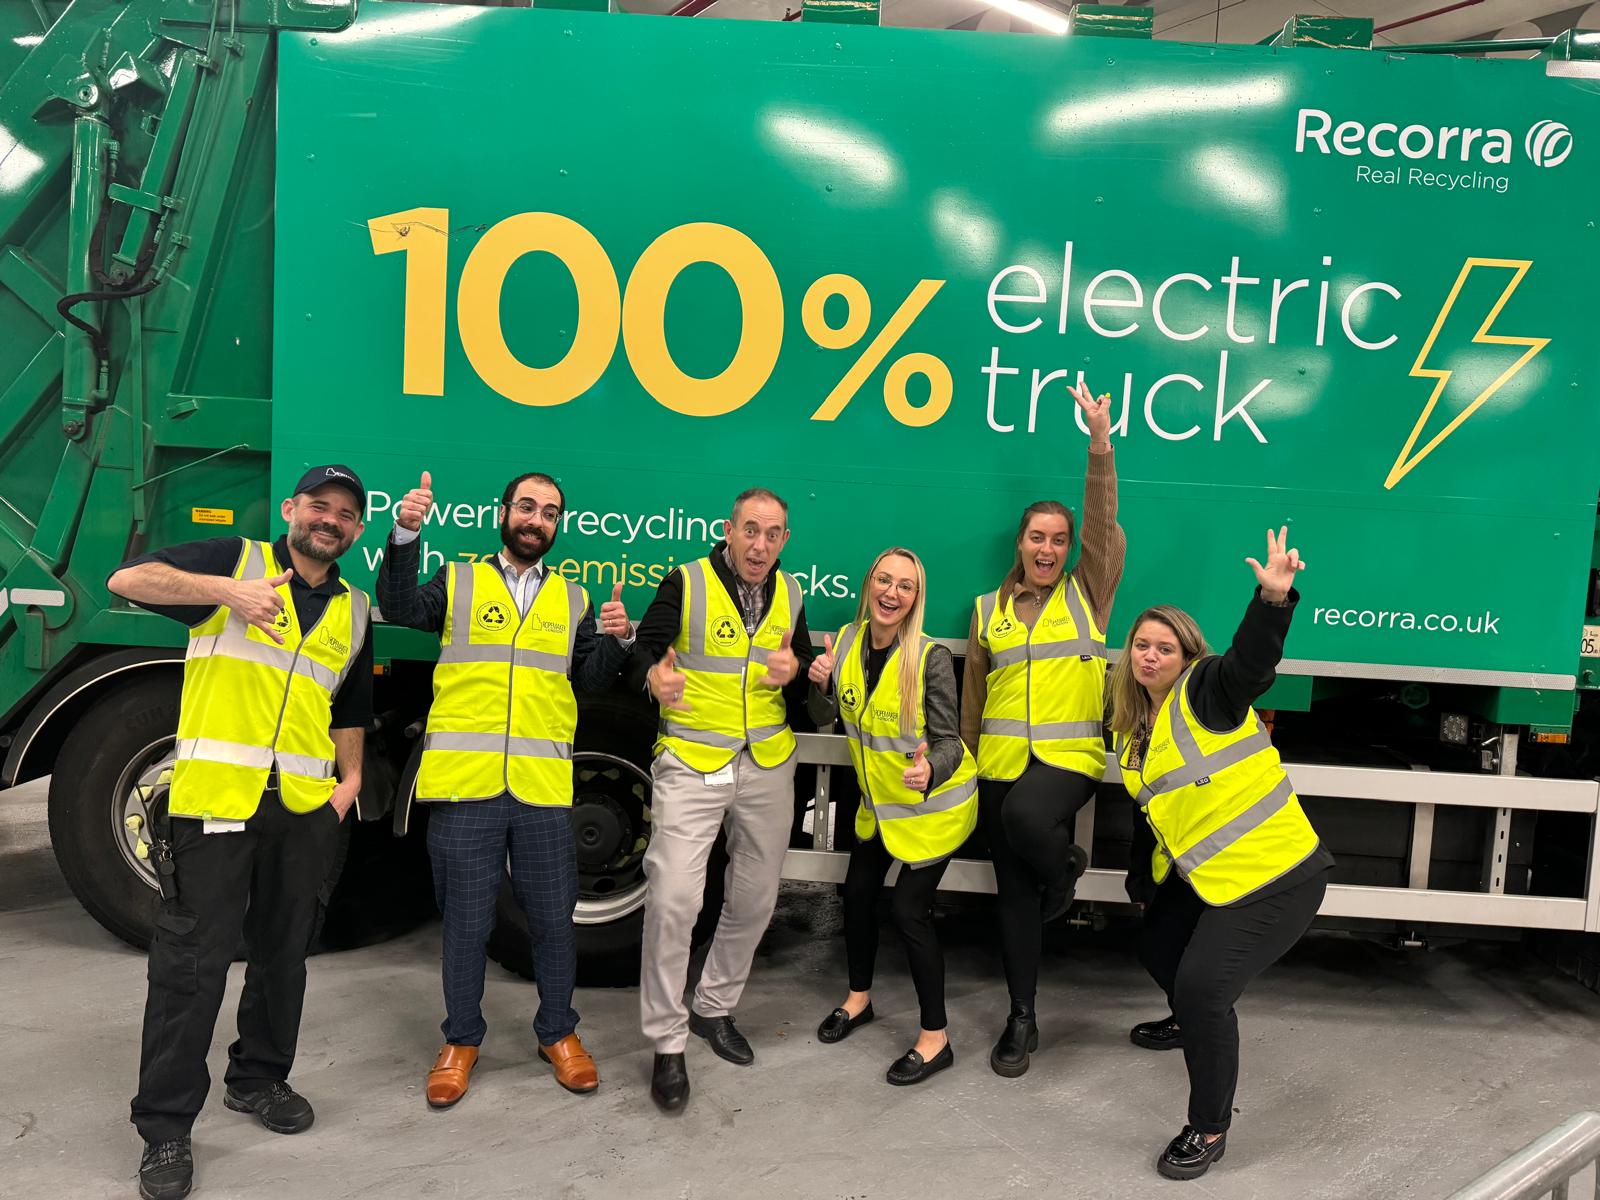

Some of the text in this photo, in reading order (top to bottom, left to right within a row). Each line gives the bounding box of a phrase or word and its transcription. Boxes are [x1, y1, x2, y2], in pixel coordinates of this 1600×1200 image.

[1295, 108, 1512, 164] Recorra
[1356, 165, 1509, 193] Real Recycling
[367, 206, 953, 427] 100%
[987, 241, 1402, 351] electric
[981, 346, 1272, 444] truck
[1313, 607, 1500, 635] recorra.co.uk
